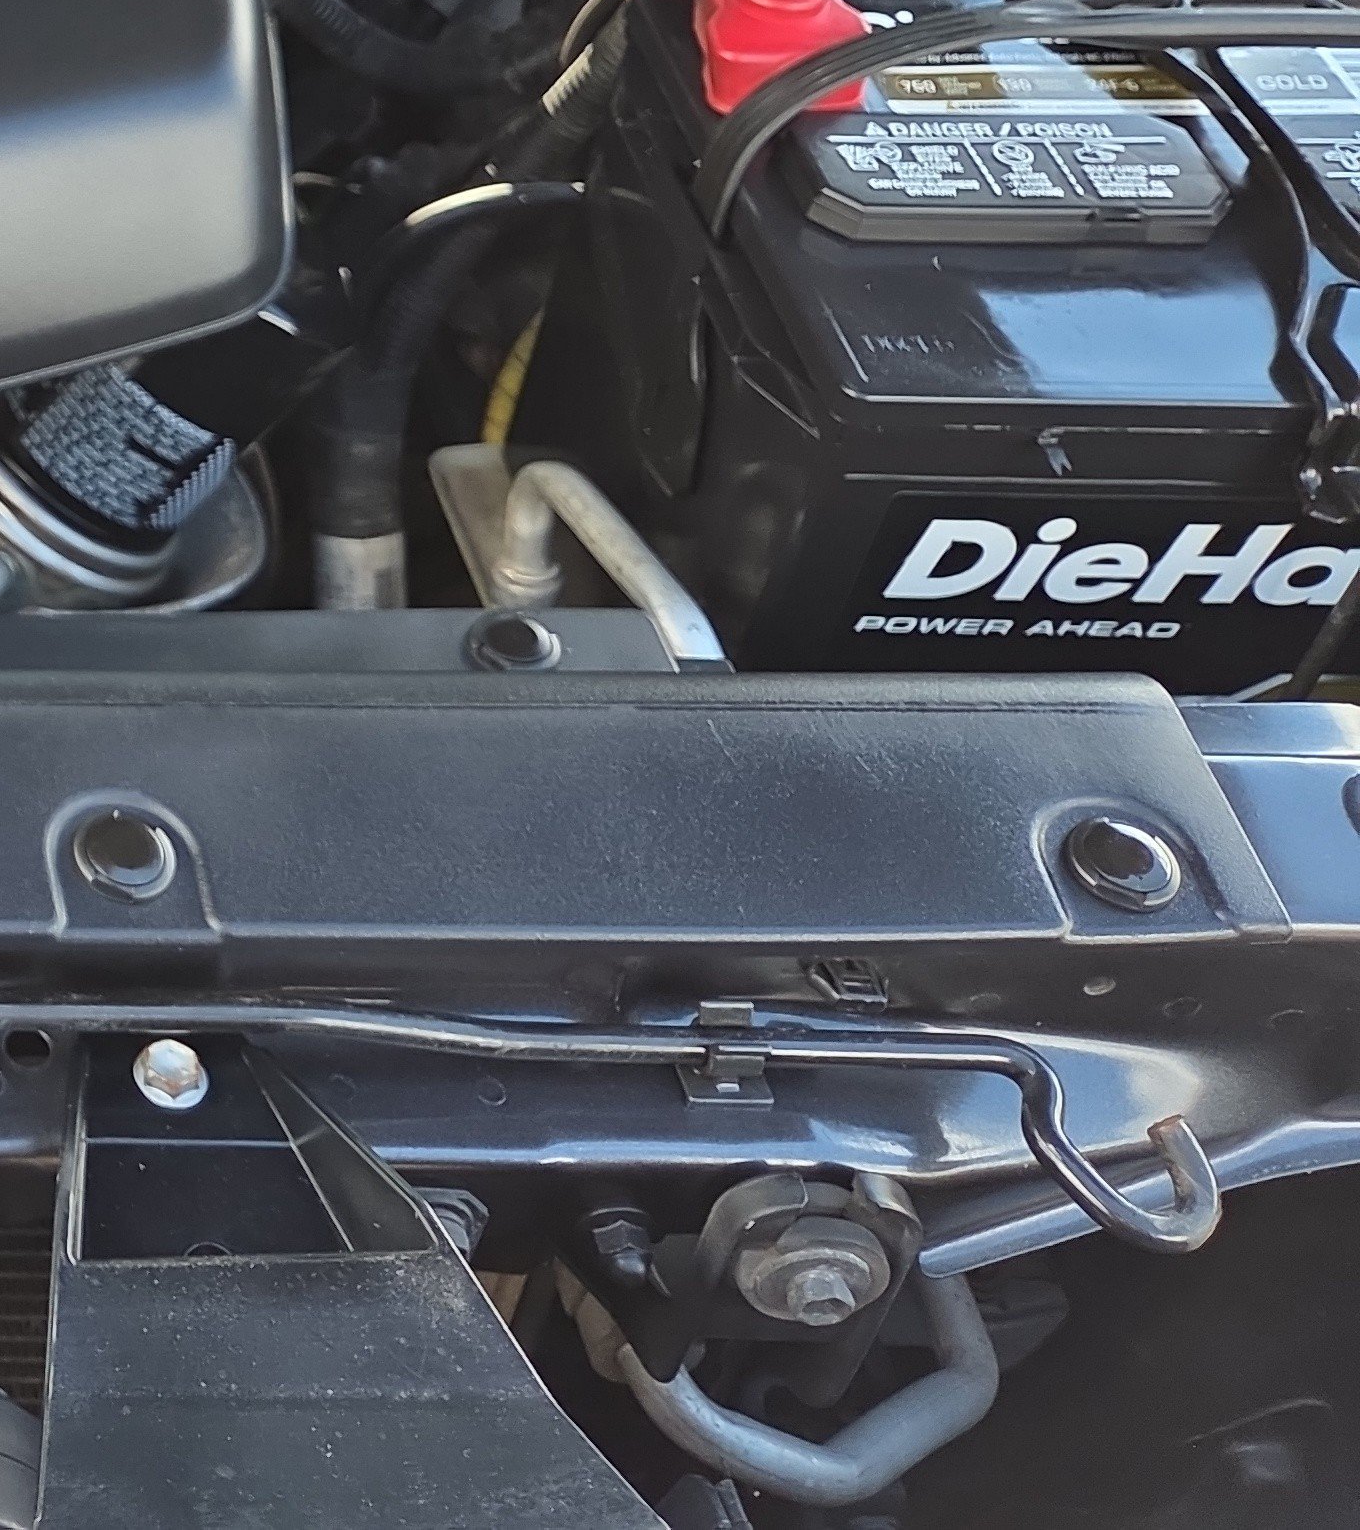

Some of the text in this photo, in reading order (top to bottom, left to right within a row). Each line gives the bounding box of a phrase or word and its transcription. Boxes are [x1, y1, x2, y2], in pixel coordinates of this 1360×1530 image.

[1256, 74, 1329, 91] GOLD
[887, 121, 994, 138] DANGER
[1015, 121, 1114, 138] POISON
[854, 615, 1180, 640] POWER AHEAD
